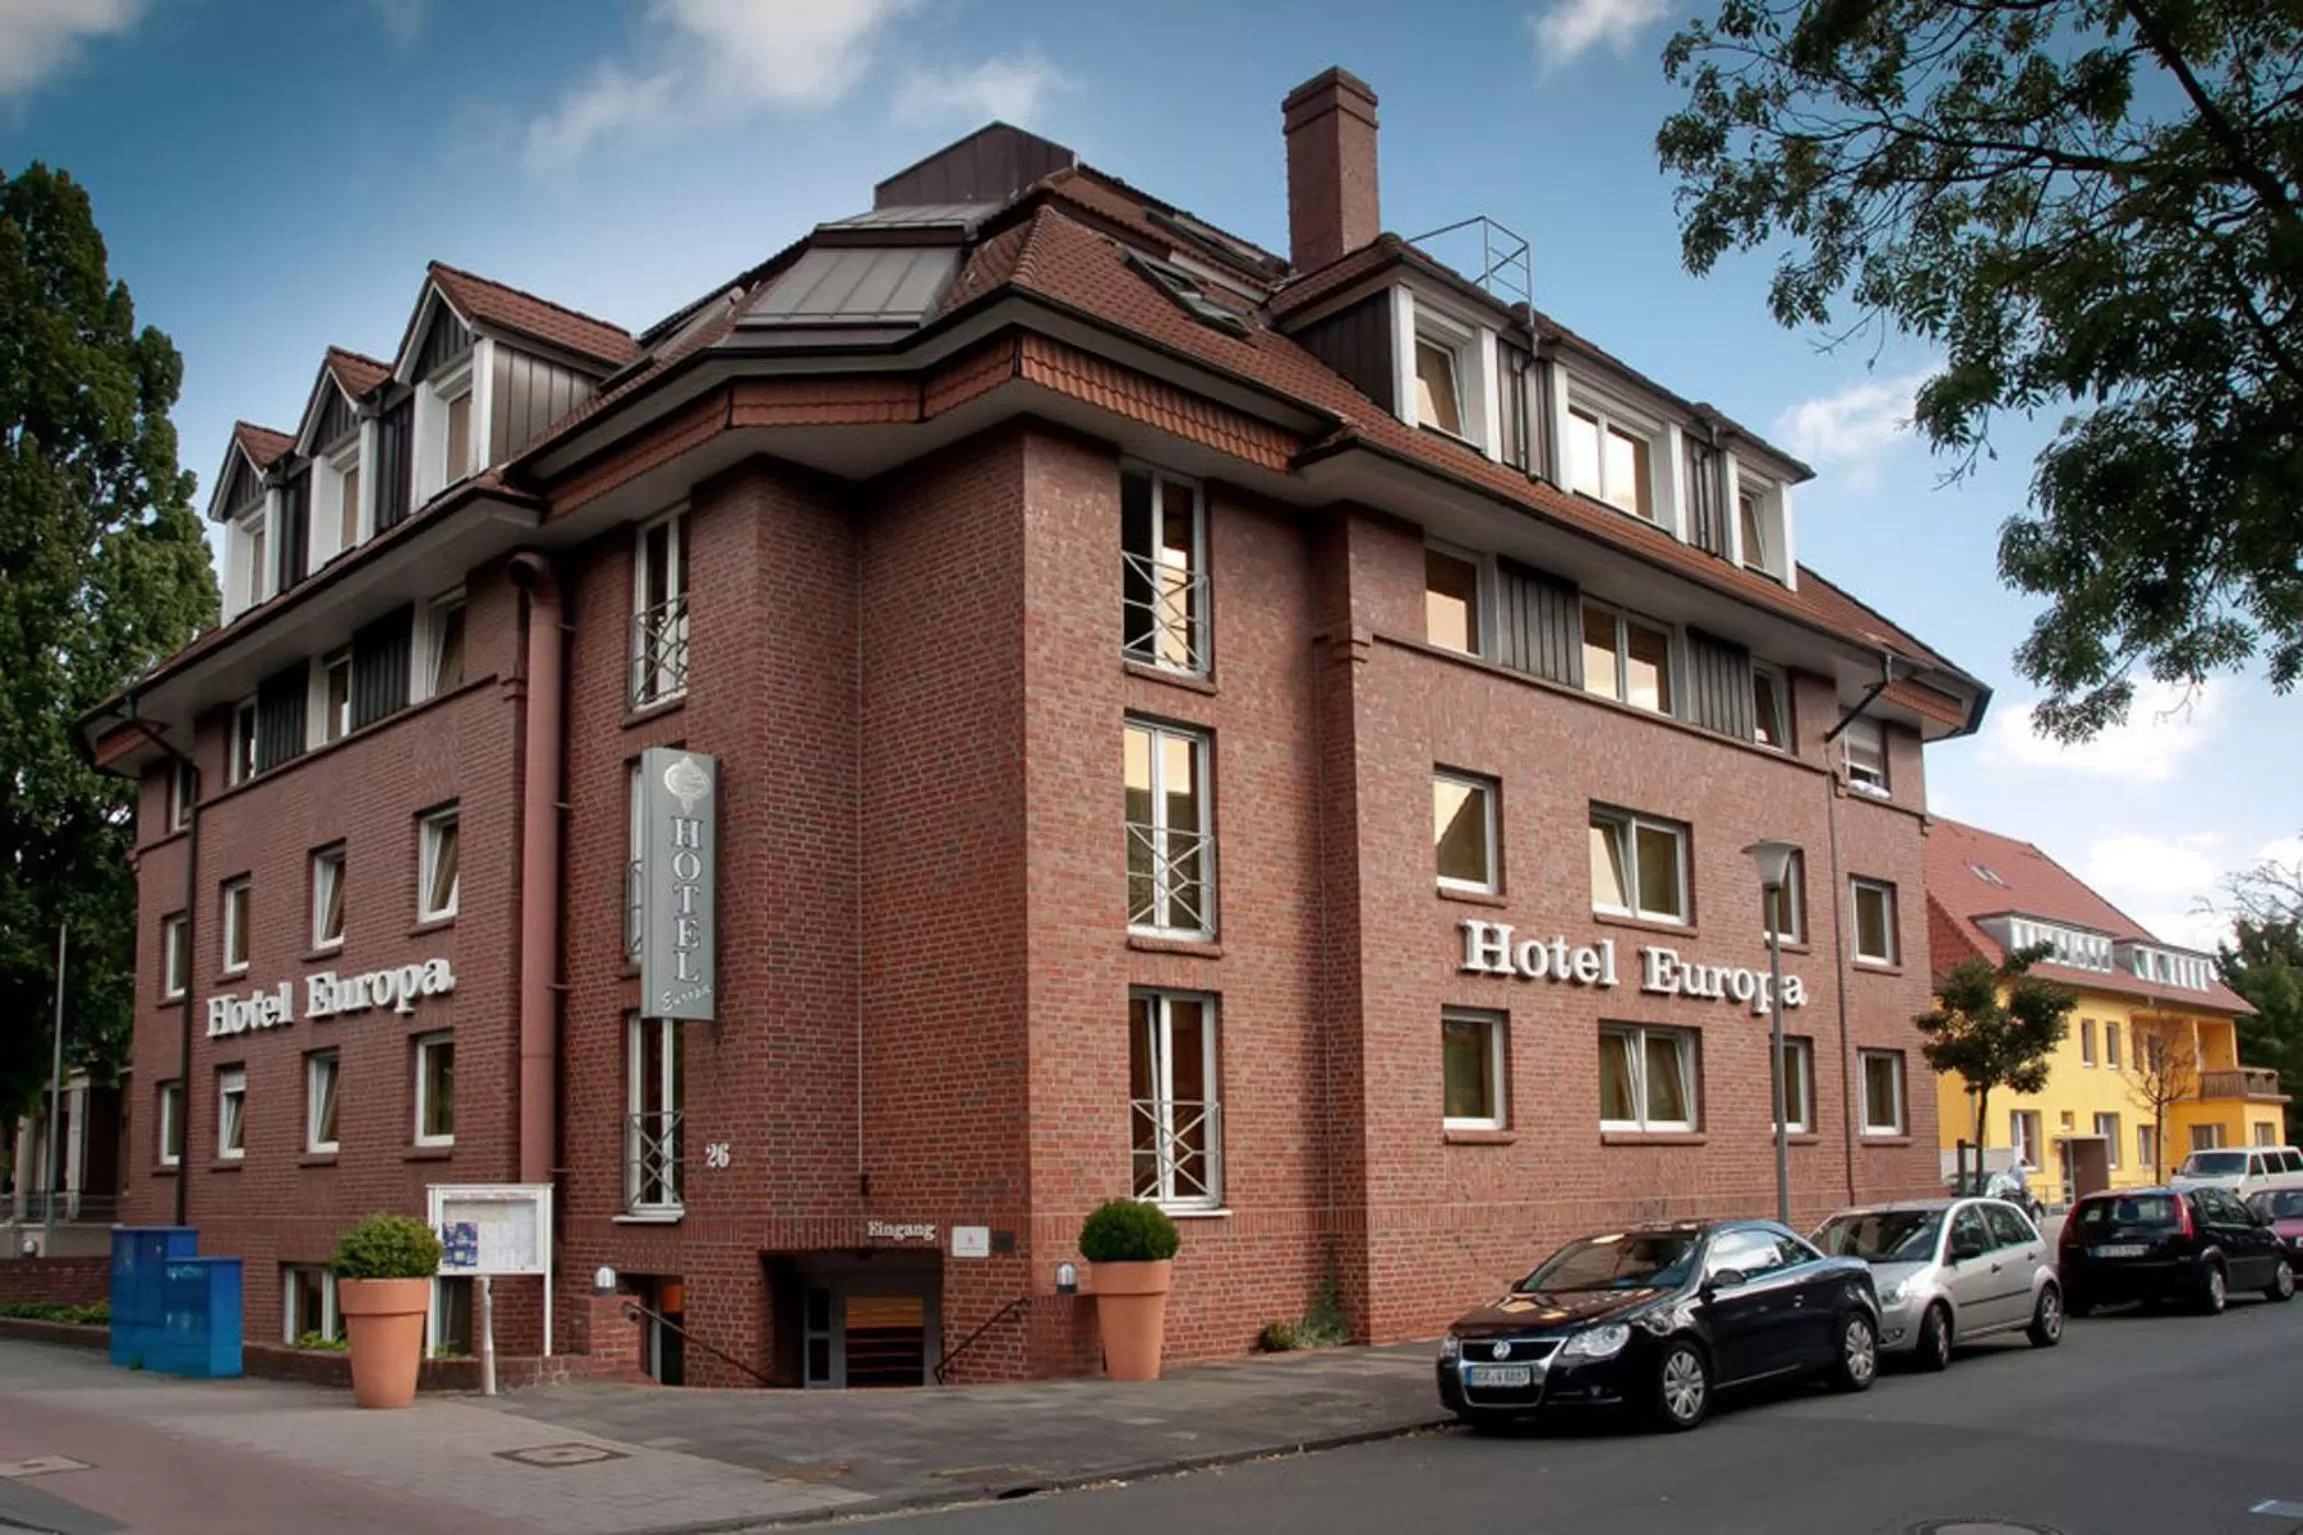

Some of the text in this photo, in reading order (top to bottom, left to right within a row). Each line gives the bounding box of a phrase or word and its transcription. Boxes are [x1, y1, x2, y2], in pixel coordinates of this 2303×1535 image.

[671, 817, 703, 983] HOTEL
[207, 958, 456, 1036] Hotel Europa
[1460, 918, 1807, 1014] Hotel Europa
[705, 1143, 730, 1168] 26
[867, 1220, 936, 1241] Eingang
